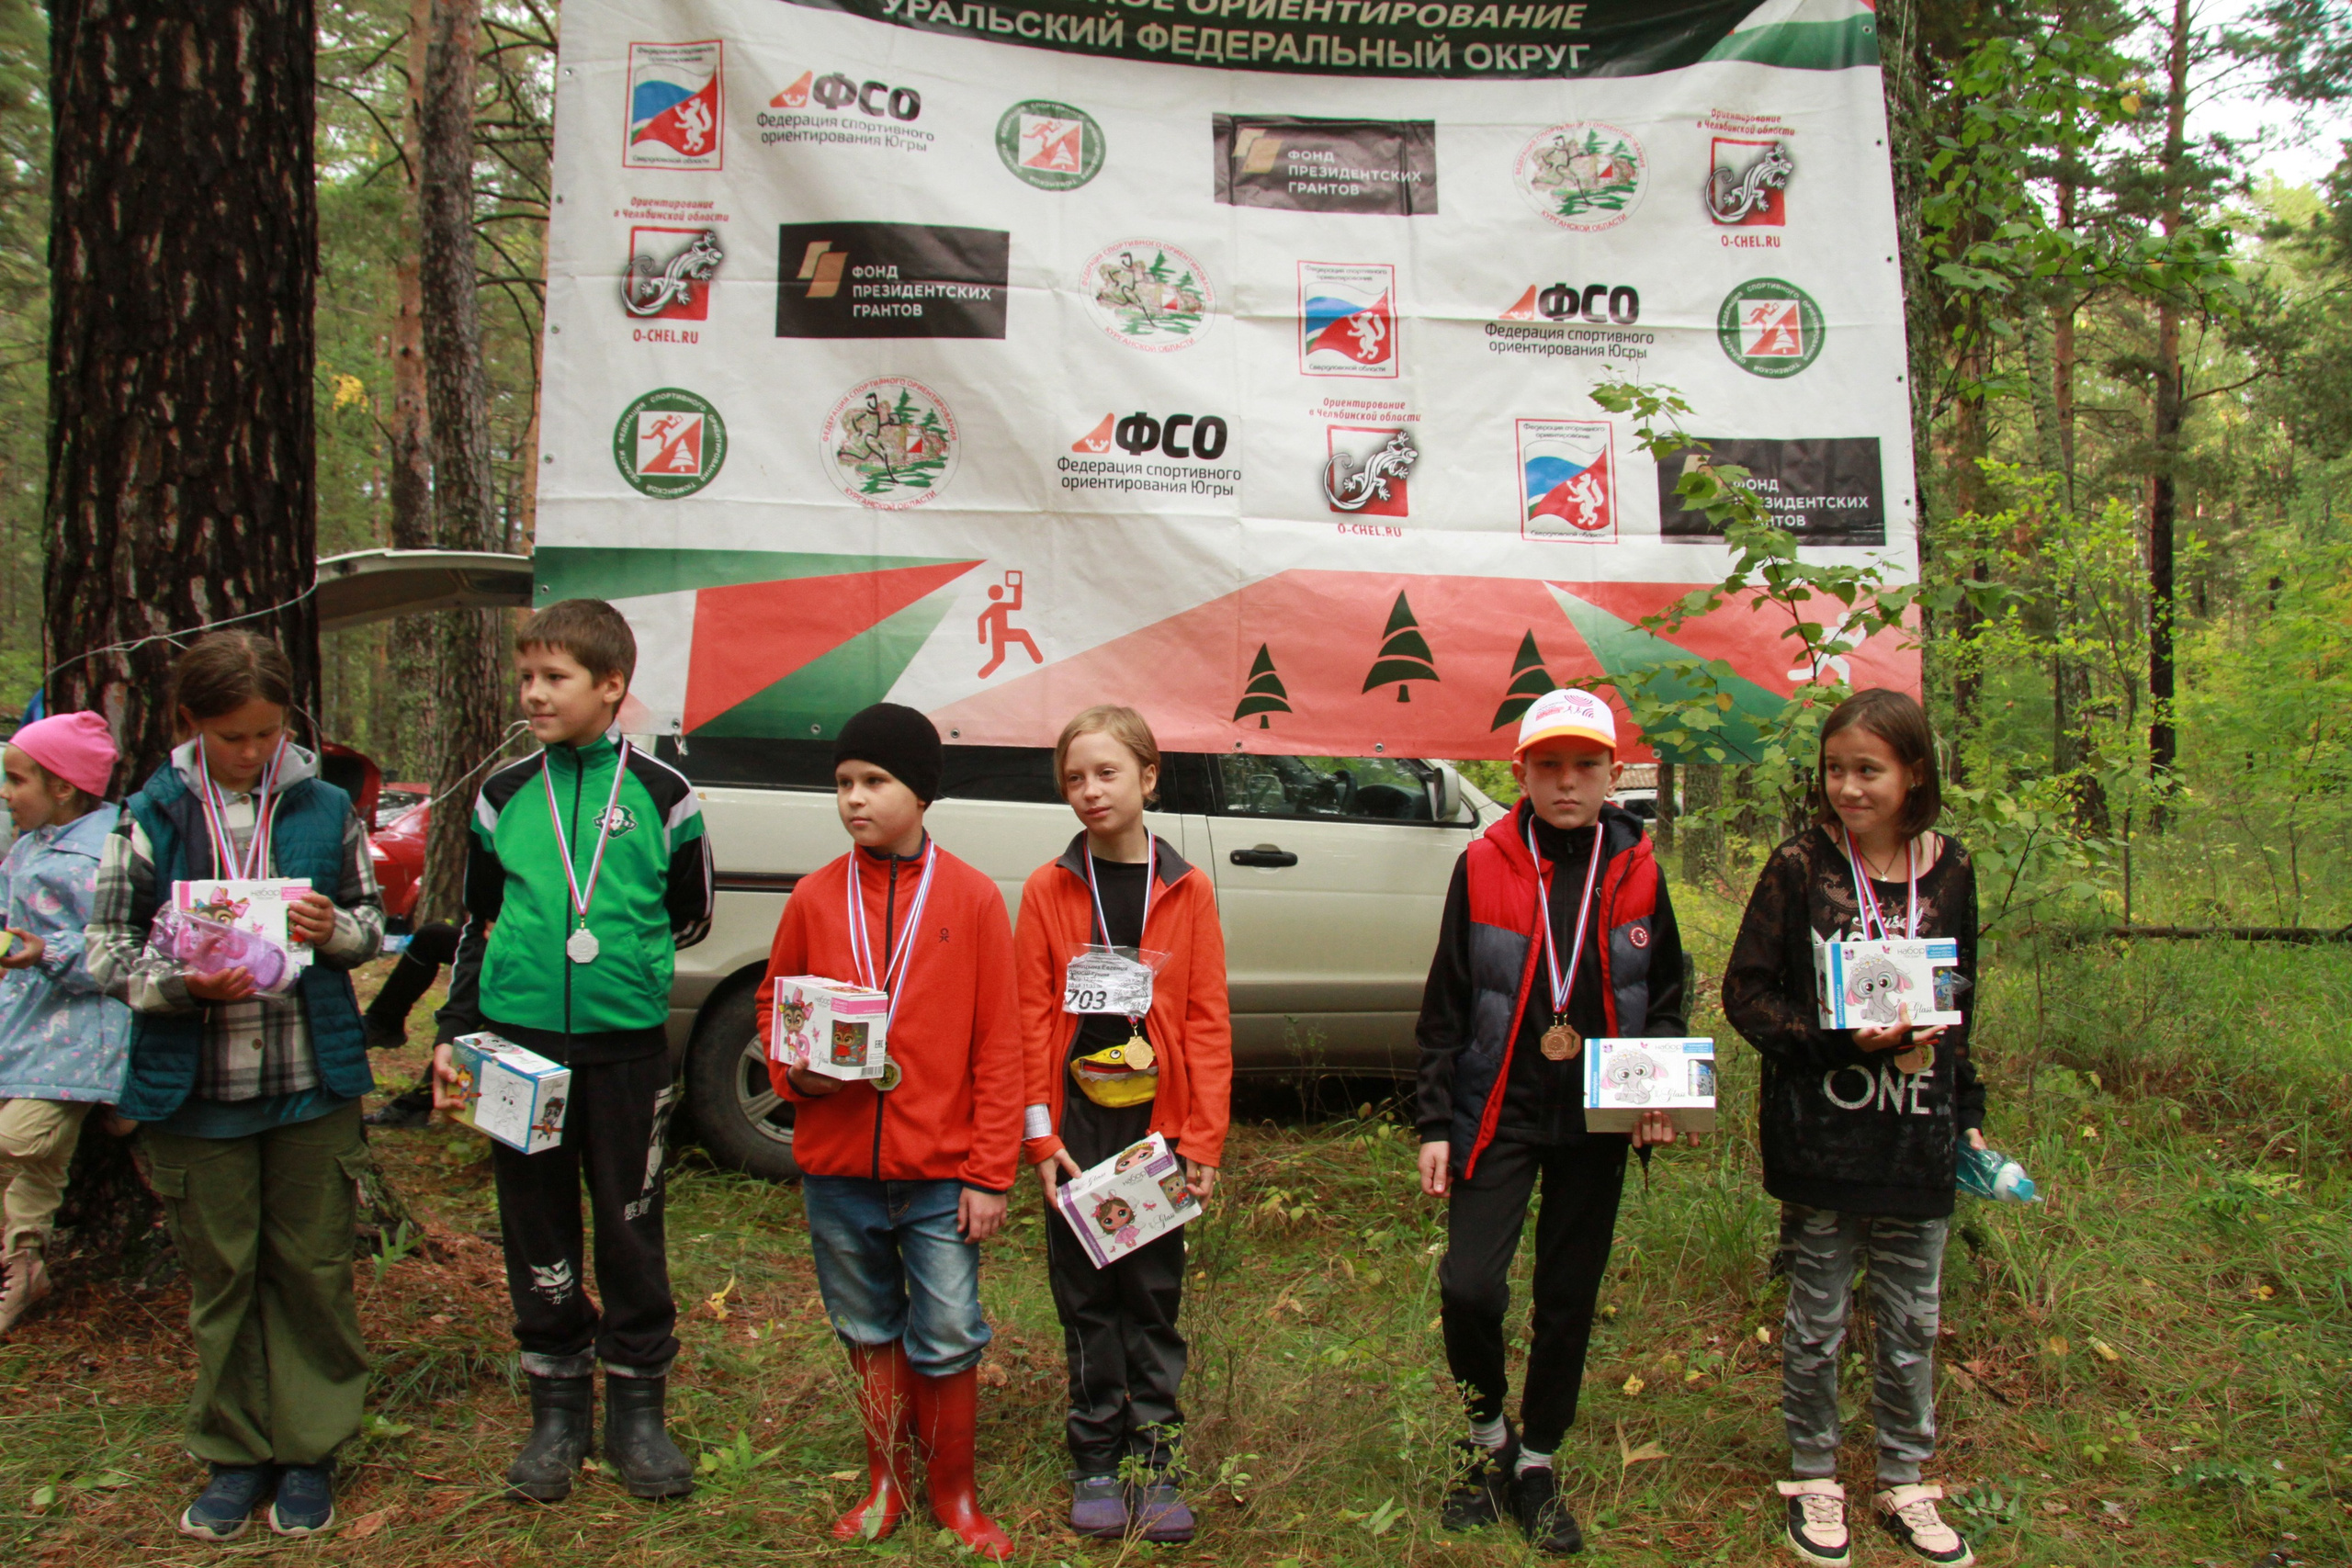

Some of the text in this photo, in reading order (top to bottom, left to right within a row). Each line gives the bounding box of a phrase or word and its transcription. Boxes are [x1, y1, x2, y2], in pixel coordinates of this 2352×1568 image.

[1187, 0, 1588, 30] ОРИЕНТИРОВАНИЕ
[1136, 22, 1452, 69] ФЕДЕРАЛЬНЫЙ
[1464, 43, 1590, 71] ОКРУГ
[812, 71, 922, 122] ФСО
[1711, 107, 1781, 124] Ориентирование
[756, 110, 935, 141] Федерация спортивного
[1704, 119, 1755, 135] Челябинской
[1757, 124, 1795, 137] области
[761, 129, 928, 152] ориентирования Югры
[1287, 149, 1336, 164] ФОНД
[1288, 164, 1422, 183] ПРЕЗИДЕНТСКИХ
[1288, 181, 1361, 197] ГРАНТОВ
[630, 196, 715, 210] Ориентирование
[622, 209, 684, 221] Челябинской
[687, 210, 729, 222] области
[1541, 209, 1627, 232] КУРГАНСКОЙ ОБЛАСТИ
[1721, 234, 1781, 248] O-CHEL.RU
[852, 265, 899, 280] ФОНД
[853, 284, 991, 301] ПРЕЗИДЕНТСКИХ
[1747, 282, 1801, 299] СПОРТИВНОГО
[853, 303, 923, 318] ГРАНТОВ
[1538, 281, 1640, 325] ФСО
[633, 328, 699, 344] O-CHEL.RU
[1485, 321, 1655, 344] Федерация спортивного
[1488, 340, 1647, 362] ориентирования Югры
[1323, 397, 1406, 411] Ориентирование
[1317, 409, 1377, 422] Челябинской
[1379, 411, 1421, 423] области
[1114, 411, 1228, 460] ФСО
[1057, 456, 1241, 482] Федерация спортивного
[1061, 476, 1235, 499] ориентирования Югры
[1735, 496, 1870, 511] ЗИДЕНТСКИХ
[1337, 523, 1403, 537] O-CHEL.RU
[1897, 945, 1925, 956] набор
[1067, 988, 1107, 1010] 703
[1655, 1042, 1682, 1052] набор
[1823, 1063, 1935, 1115] ONE
